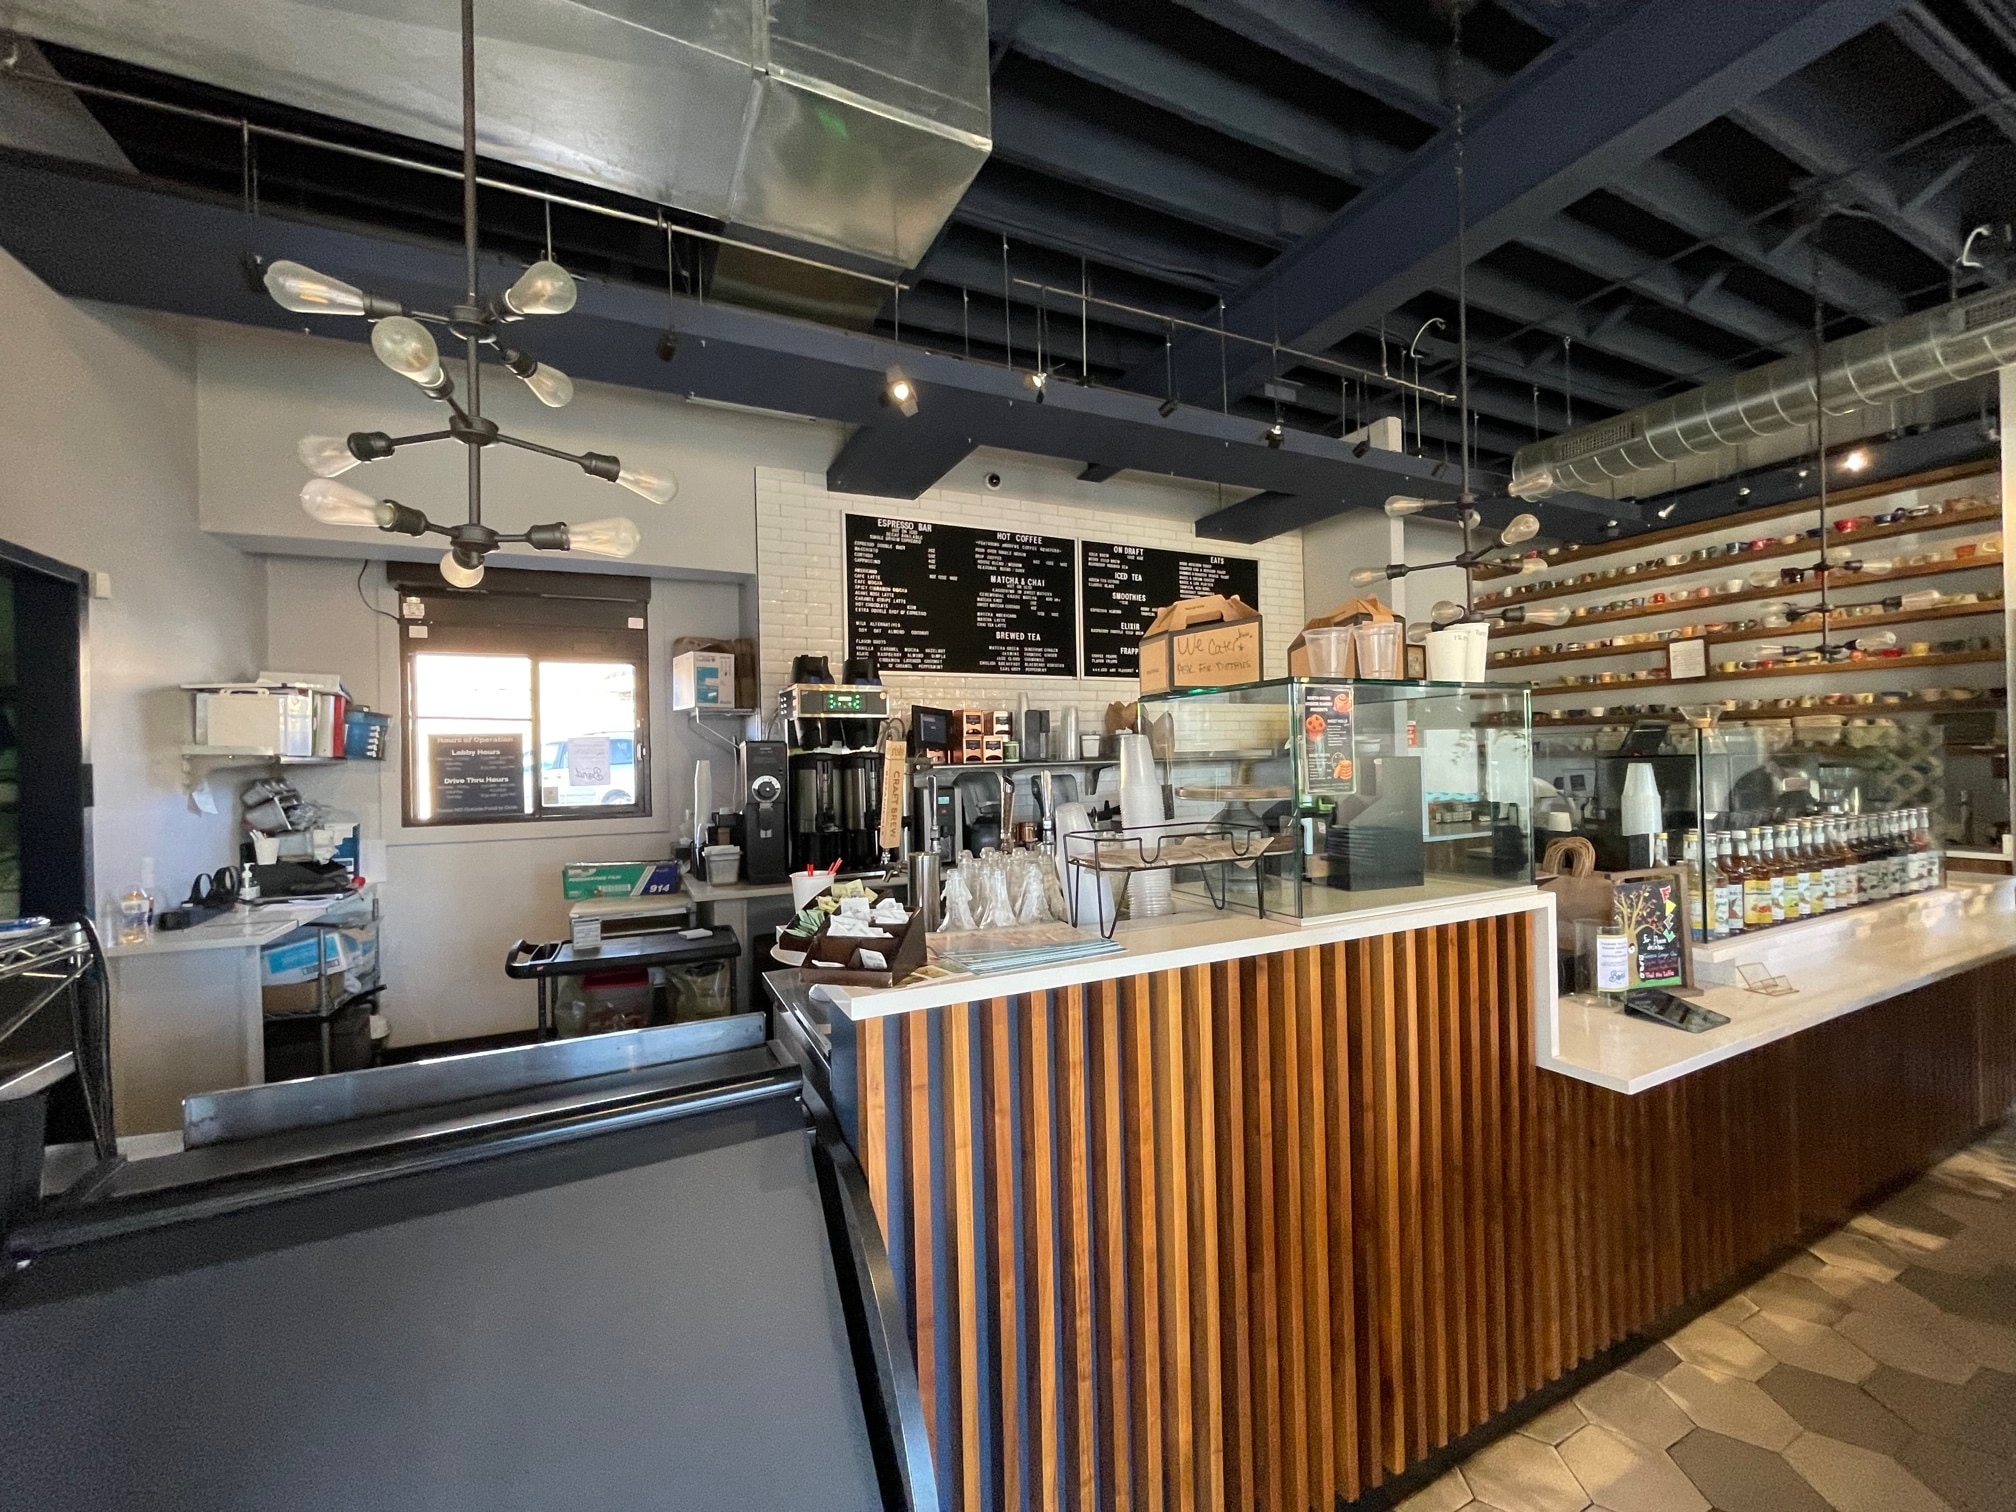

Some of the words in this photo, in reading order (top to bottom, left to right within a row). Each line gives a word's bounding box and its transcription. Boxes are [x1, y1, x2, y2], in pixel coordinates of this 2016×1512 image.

[878, 519, 913, 529] ESPRESSO
[918, 523, 932, 532] BAR
[997, 532, 1010, 540] HOT
[1016, 535, 1042, 544] COFFEE
[1125, 547, 1143, 555] DRAFT
[991, 576, 1018, 584] MATCHA
[1115, 572, 1128, 580] ICED
[1112, 592, 1146, 601] SMOOTHIES
[1121, 622, 1140, 630] ELIXIR
[996, 632, 1024, 640] BREWED
[1028, 633, 1041, 641] TEA
[1178, 635, 1203, 655] We
[890, 771, 900, 804] CRAFT
[890, 807, 898, 837] BREW
[649, 884, 670, 892] 914
